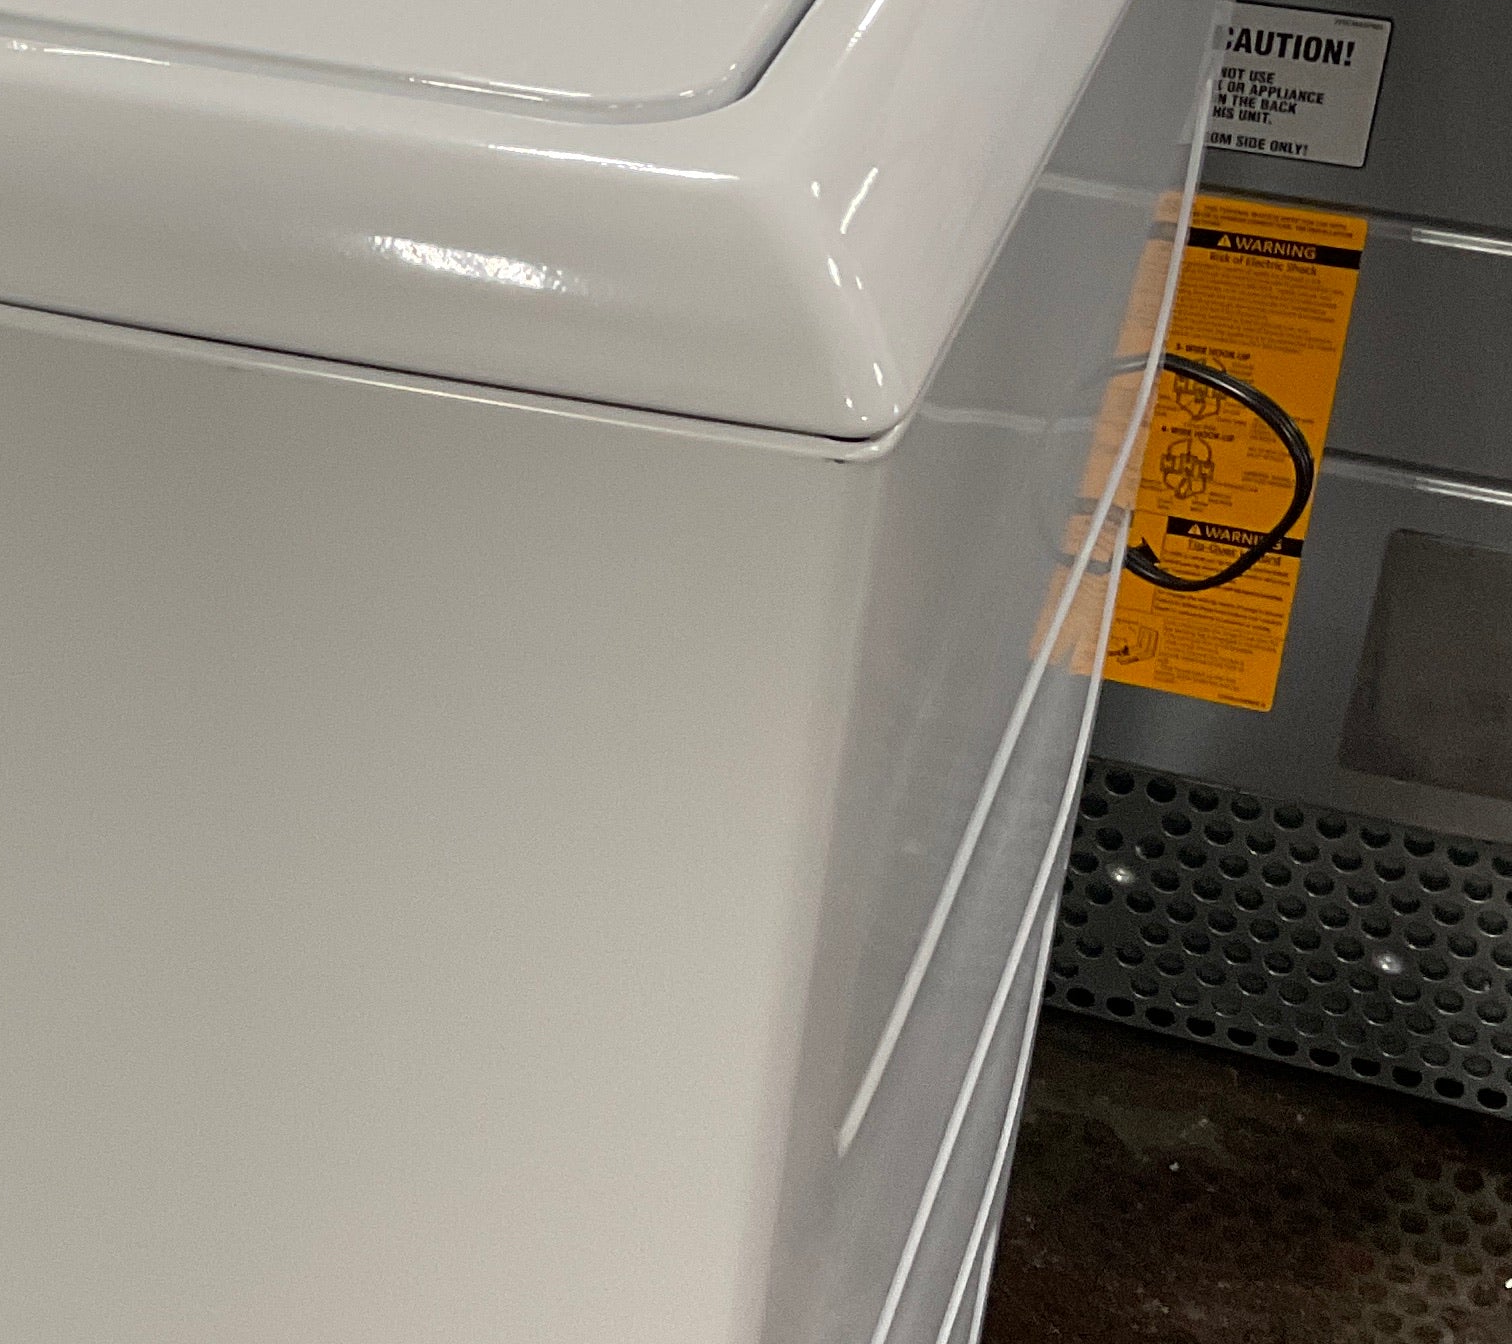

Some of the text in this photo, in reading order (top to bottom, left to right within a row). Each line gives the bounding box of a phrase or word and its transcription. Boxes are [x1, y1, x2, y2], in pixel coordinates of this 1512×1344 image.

[1226, 27, 1355, 67] AUTION!
[1249, 70, 1276, 85] USE
[1227, 80, 1245, 94] OR
[1250, 84, 1325, 105] APPLIANCE
[1232, 96, 1256, 108] THE
[1261, 99, 1298, 115] BACK
[1237, 135, 1265, 151] SIDE
[1270, 140, 1308, 156] ONLY!
[1235, 236, 1317, 260] WARNING
